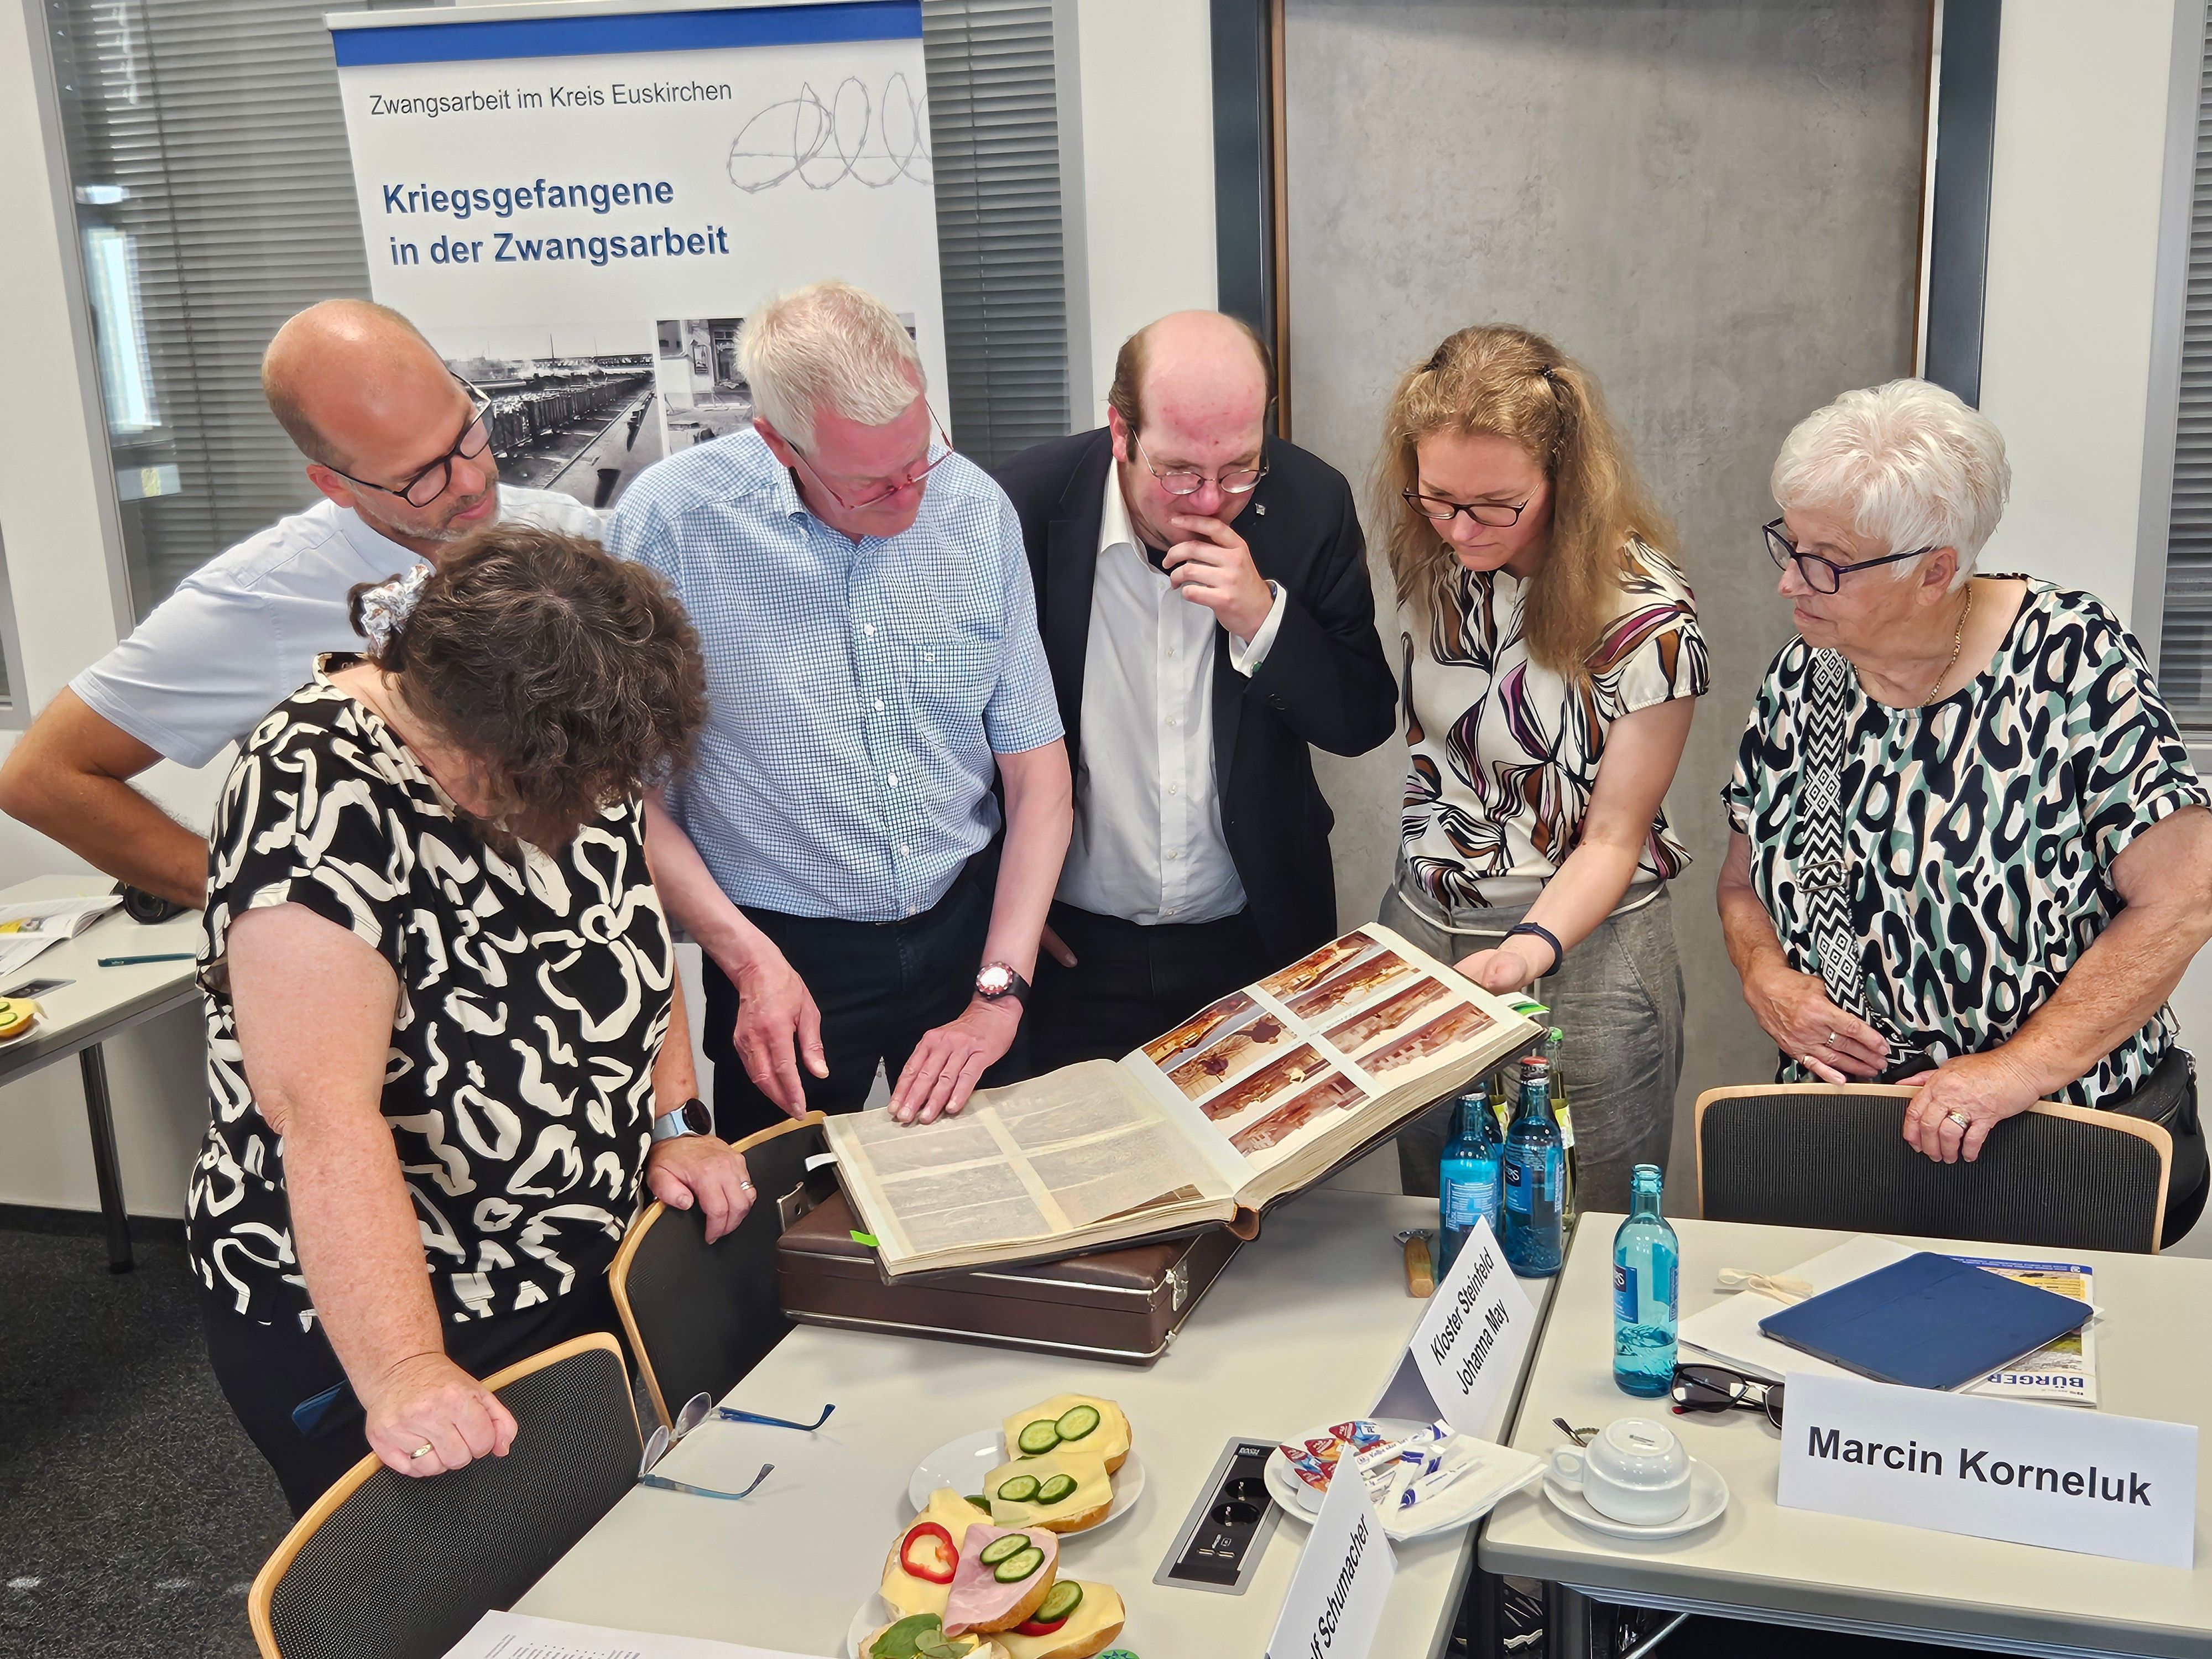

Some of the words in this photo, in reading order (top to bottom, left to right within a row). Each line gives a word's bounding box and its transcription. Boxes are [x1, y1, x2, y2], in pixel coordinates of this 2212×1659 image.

[369, 90, 511, 118] Zwangsarbeit
[518, 88, 542, 108] im
[550, 85, 604, 107] Kreis
[612, 81, 732, 105] Euskirchen
[383, 179, 674, 220] Kriegsgefangene
[390, 237, 419, 265] in
[430, 235, 484, 264] der
[493, 226, 730, 267] Zwangsarbeit
[1431, 1306, 1464, 1366] Kloster
[1458, 1246, 1494, 1314] Steinfeld
[1456, 1328, 1494, 1395] Johanna
[1485, 1298, 1509, 1335] May
[1986, 1374, 2084, 1389] BÜRGER
[1808, 1426, 1942, 1475] Marcin
[1959, 1448, 2152, 1507] Korneluk
[1310, 1632, 1324, 1659] lf
[1318, 1513, 1369, 1648] Schumacher
